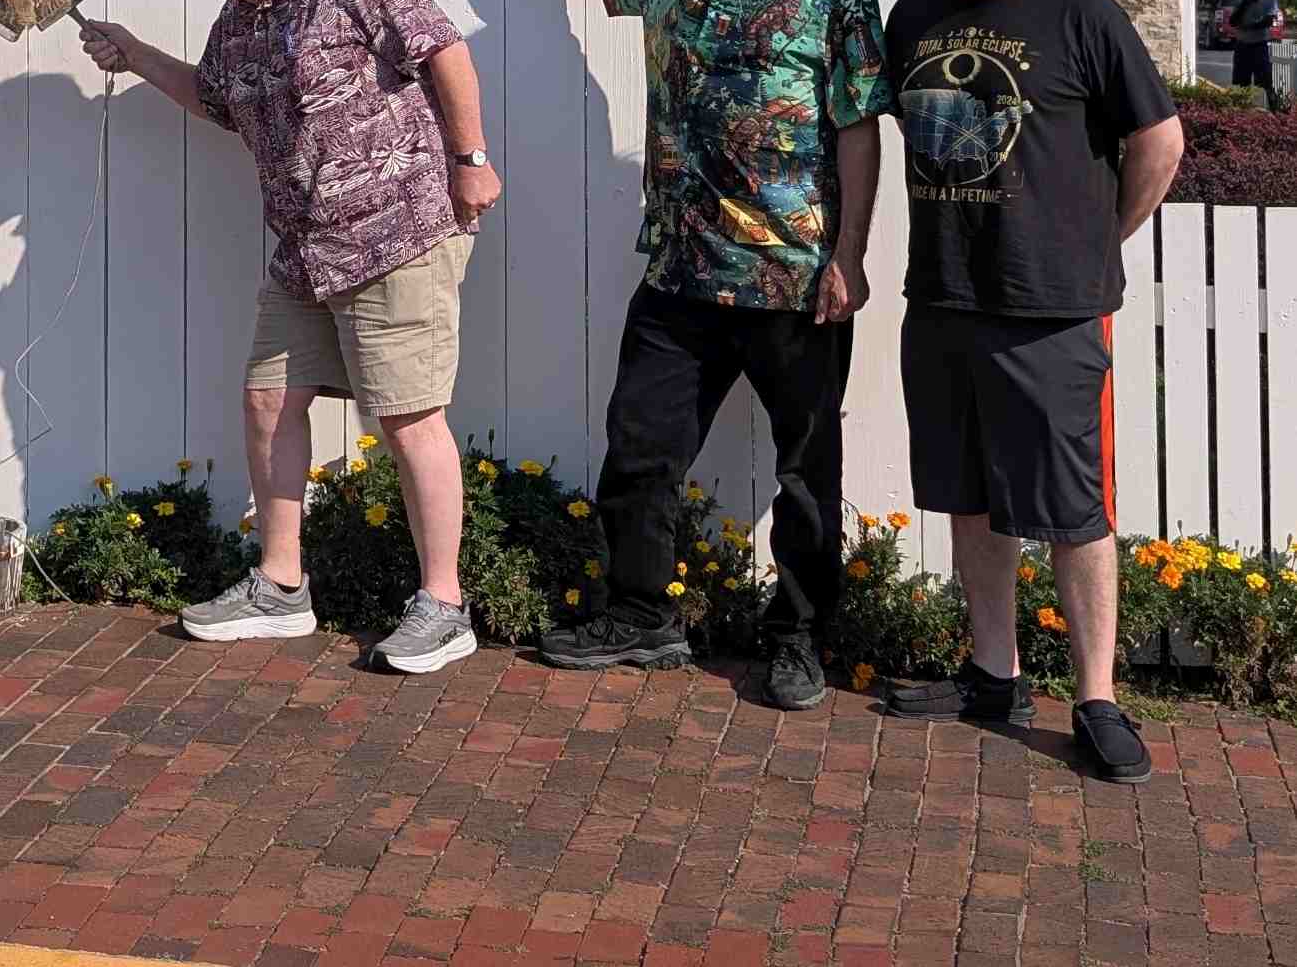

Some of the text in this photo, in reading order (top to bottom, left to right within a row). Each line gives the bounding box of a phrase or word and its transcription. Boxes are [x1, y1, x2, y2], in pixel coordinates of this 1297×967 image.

[914, 38, 1025, 61] TOTAL SOLAR ECLIPSE
[996, 95, 1018, 105] 2024
[939, 187, 946, 200] A
[951, 188, 1003, 202] LIFETIME
